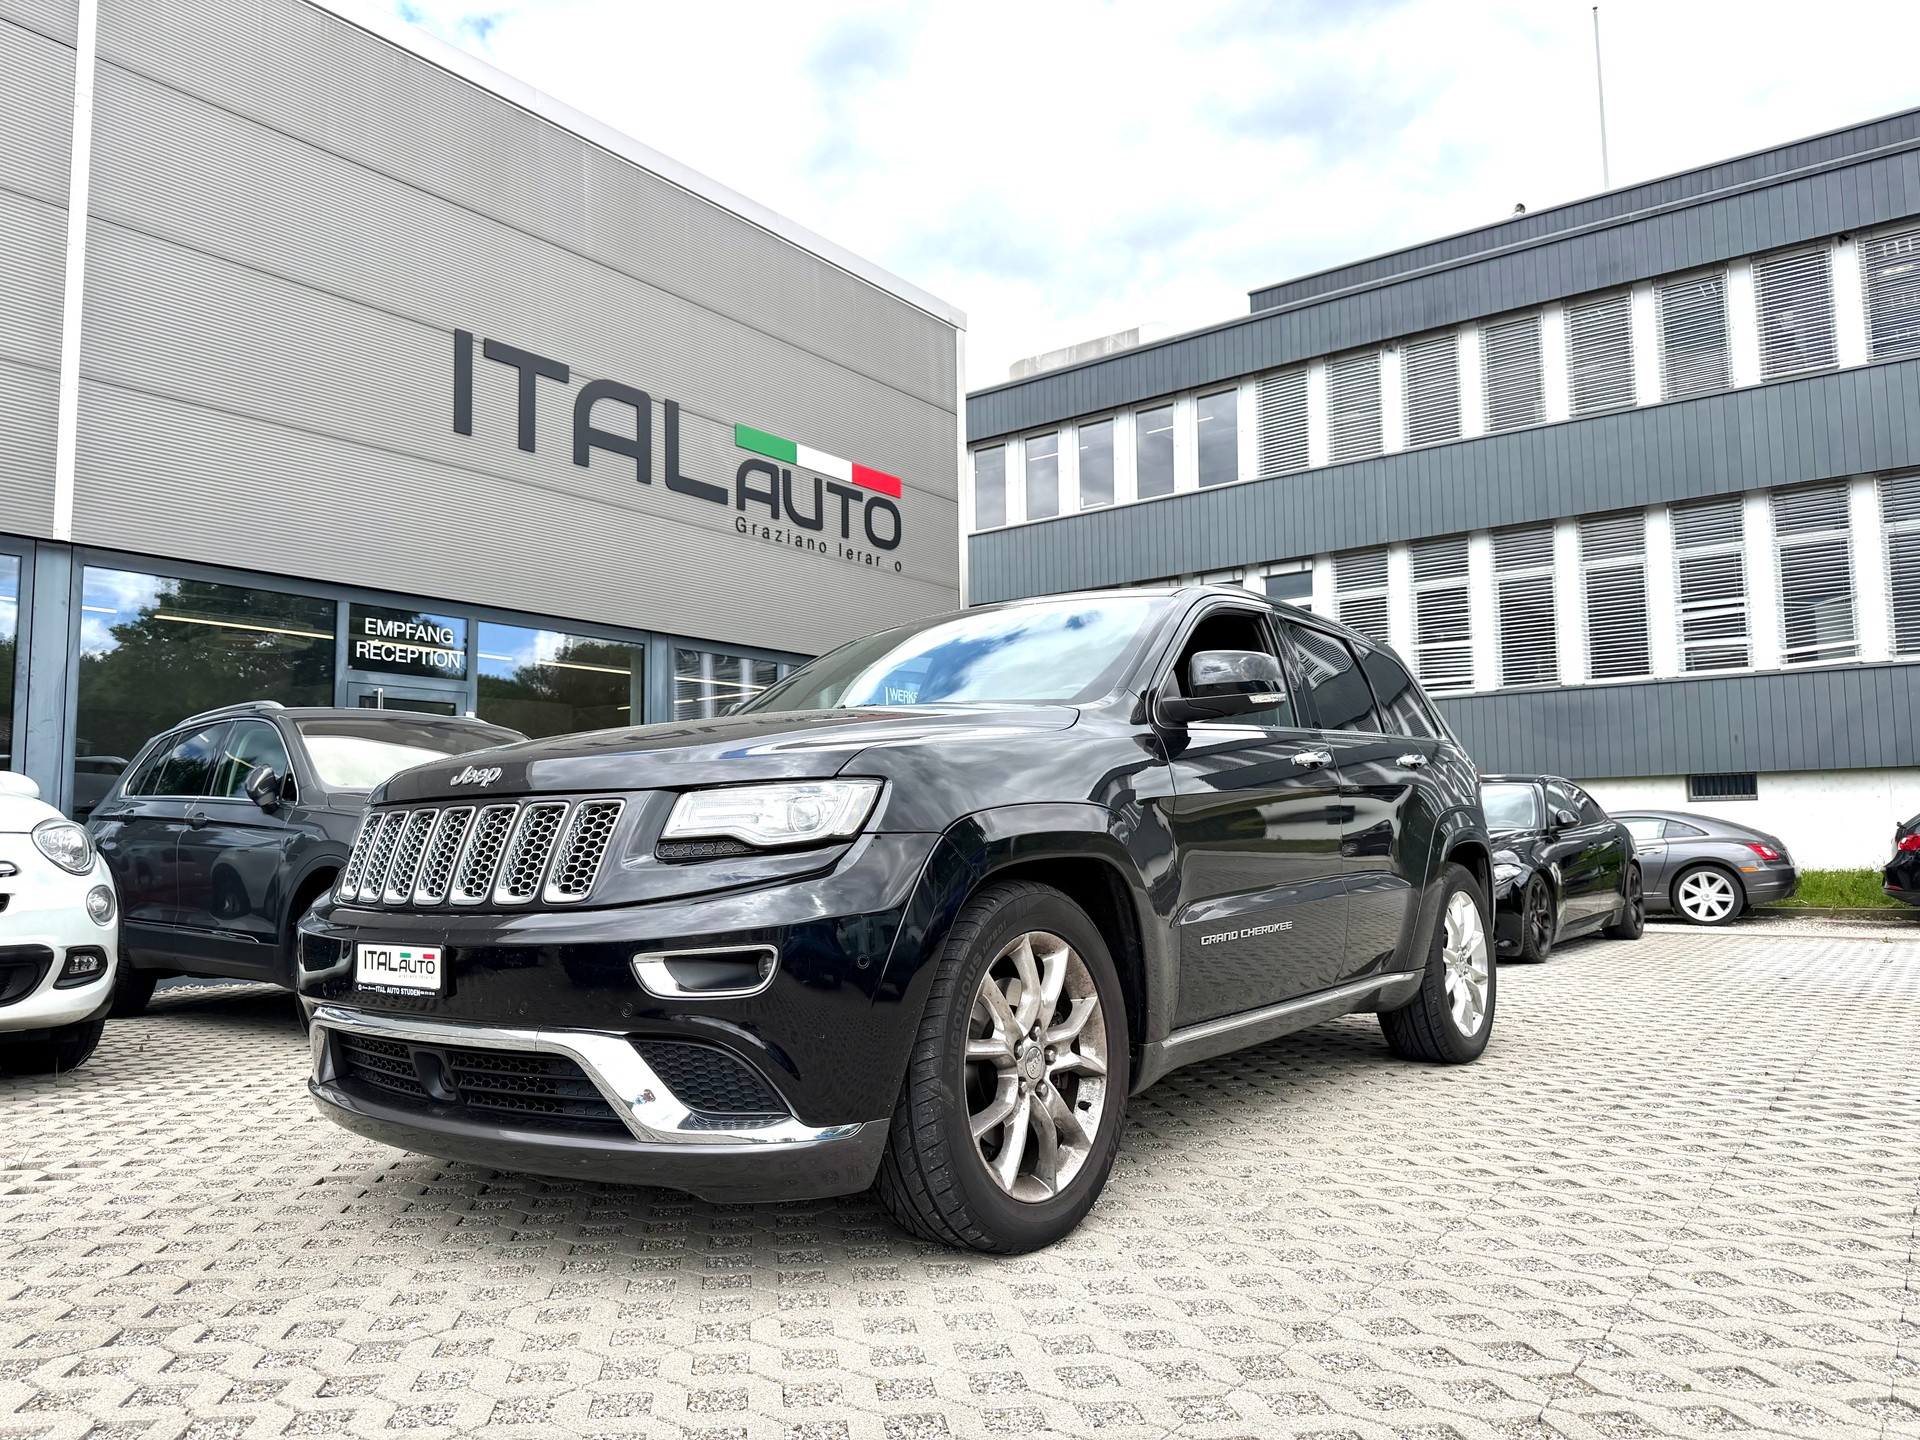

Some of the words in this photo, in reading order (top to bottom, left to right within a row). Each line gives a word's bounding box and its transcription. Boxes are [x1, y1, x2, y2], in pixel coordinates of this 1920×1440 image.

[735, 516, 827, 554] Graziano
[364, 617, 454, 645] EMPFANG
[355, 639, 462, 669] RÉCEPTION
[450, 765, 503, 788] Jeep
[1200, 930, 1239, 946] GRAND
[1240, 920, 1293, 938] CHEROKEE
[948, 951, 984, 1073] VIGOROUS
